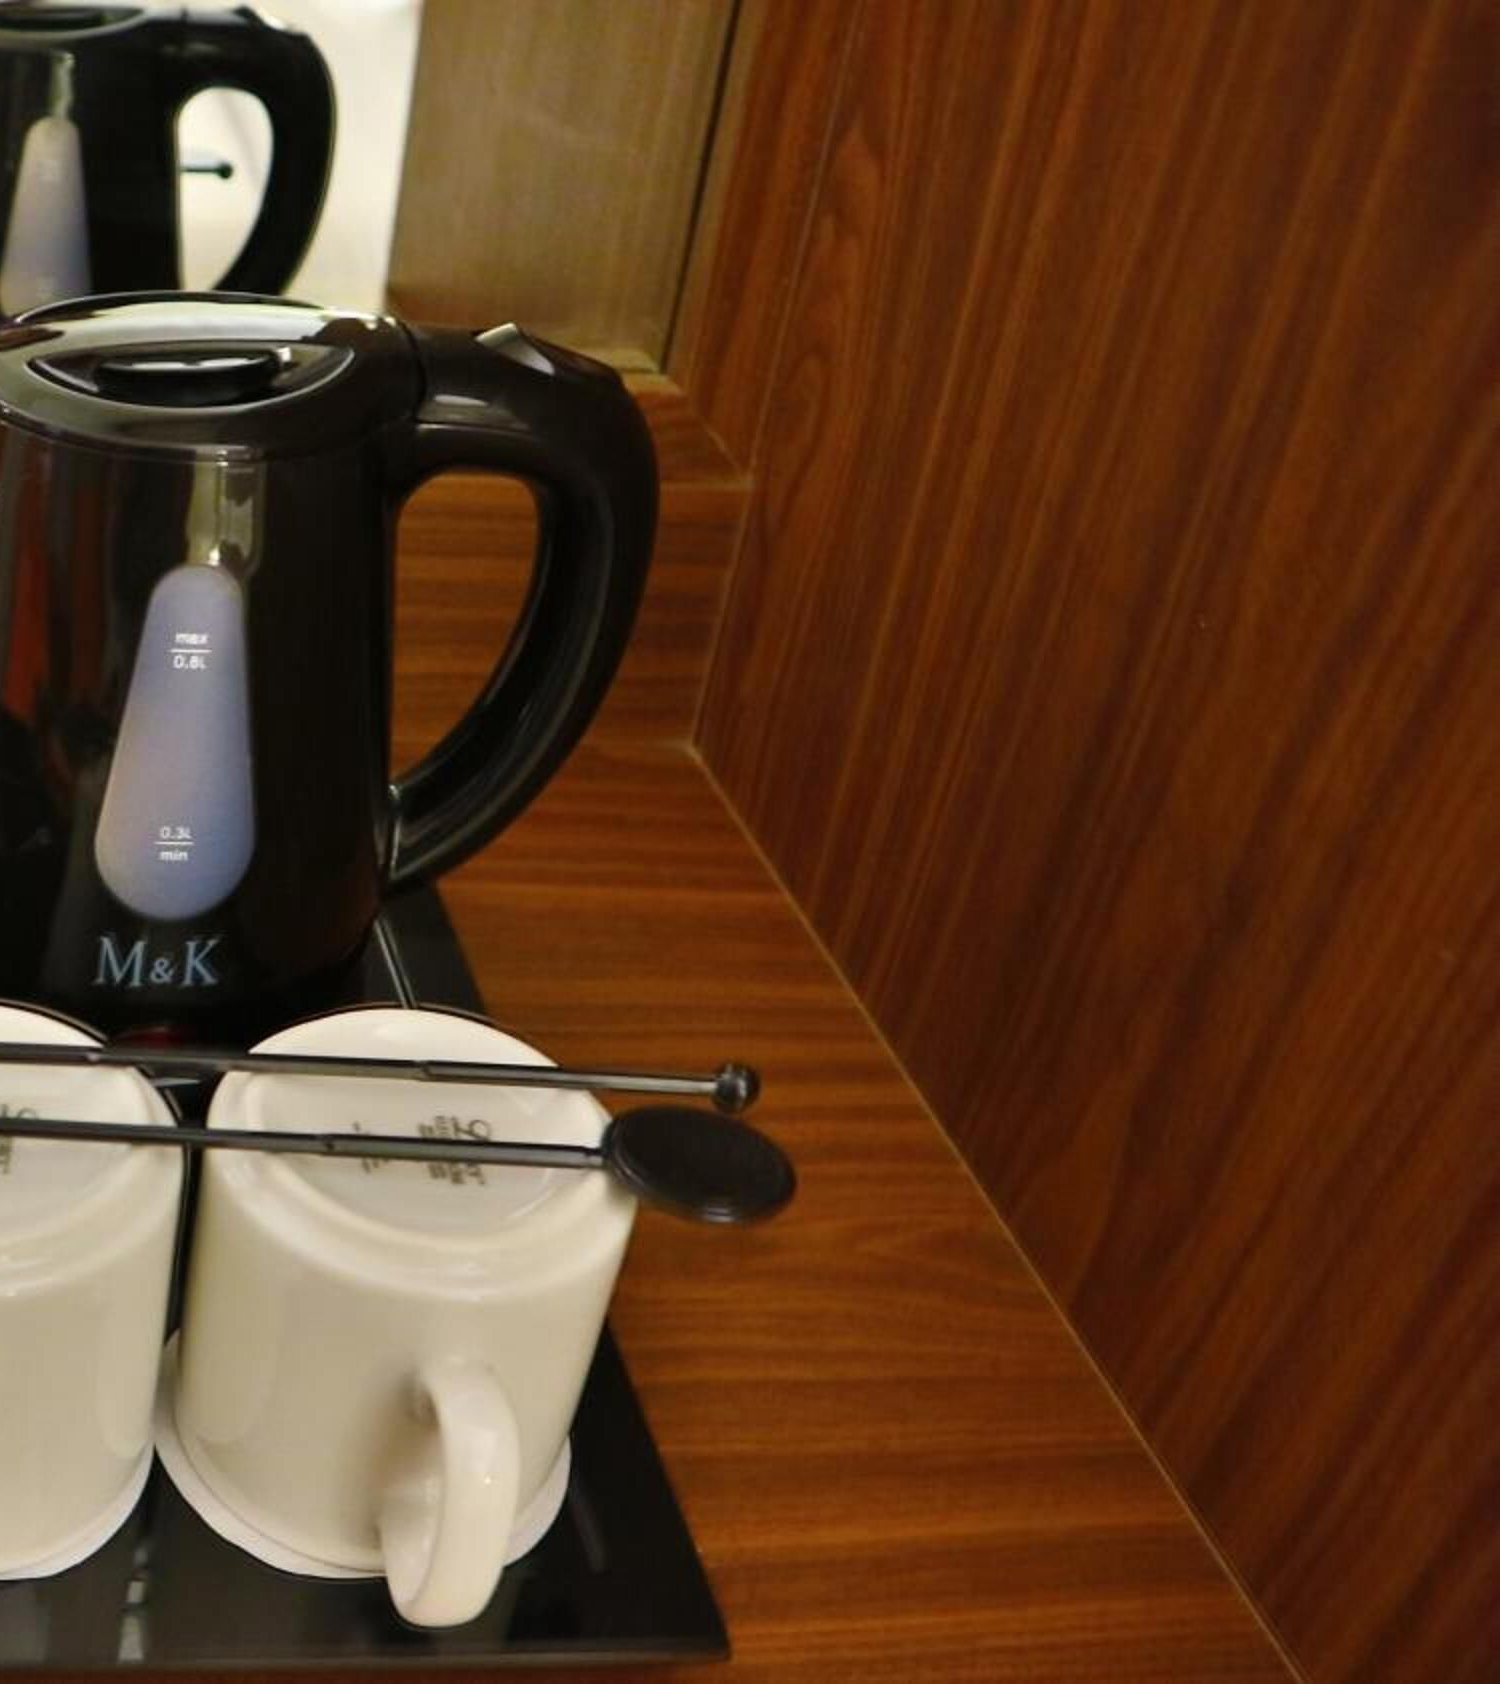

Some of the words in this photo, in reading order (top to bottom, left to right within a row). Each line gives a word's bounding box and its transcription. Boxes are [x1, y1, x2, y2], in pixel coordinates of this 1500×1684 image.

[175, 632, 208, 645] max
[159, 848, 189, 861] min
[90, 935, 220, 987] M&K
